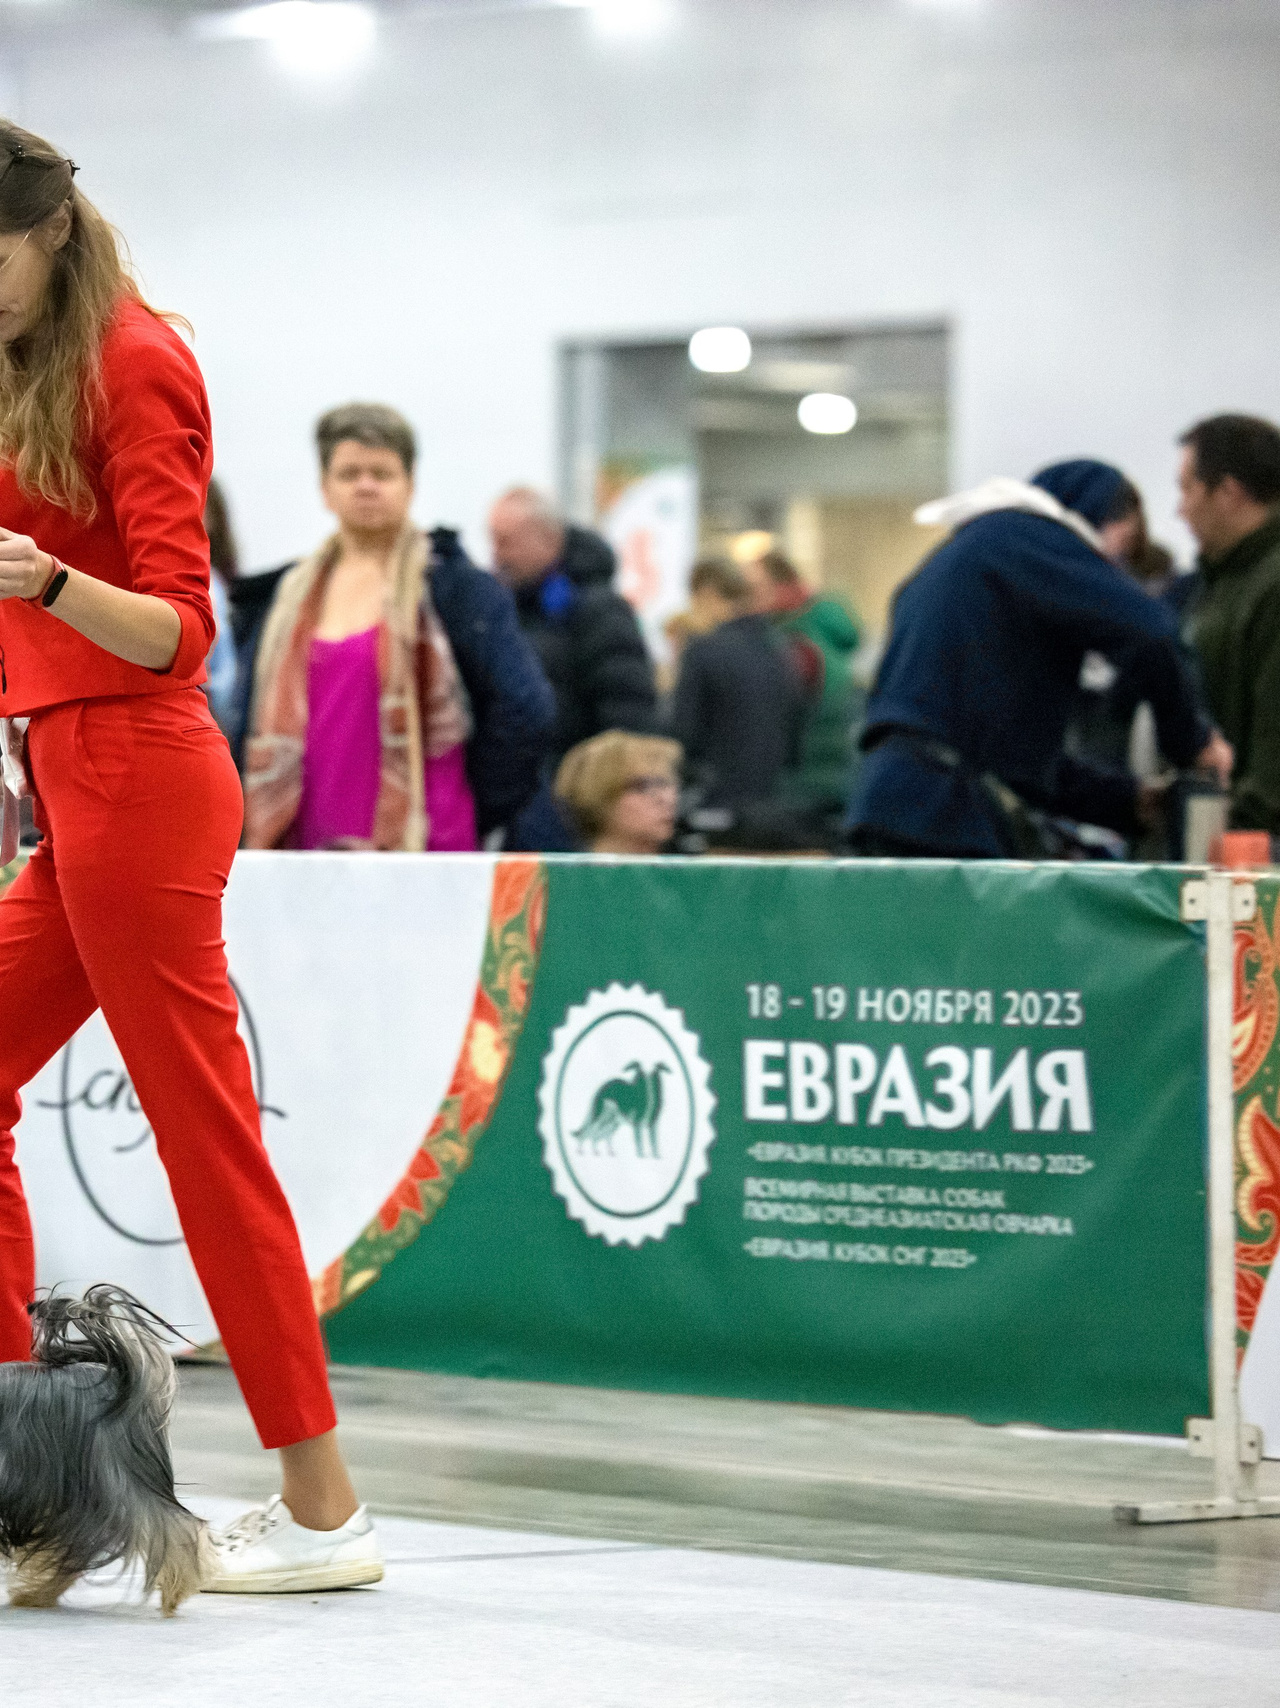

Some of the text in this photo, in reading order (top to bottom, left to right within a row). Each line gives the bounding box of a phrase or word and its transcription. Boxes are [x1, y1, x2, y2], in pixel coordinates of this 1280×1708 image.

[746, 984, 781, 1020] 18
[813, 986, 847, 1020] 19
[857, 988, 993, 1024] НОЯБРЯ
[1002, 991, 1084, 1027] 2023
[744, 1039, 1093, 1132] ЕВРАЗИЯ
